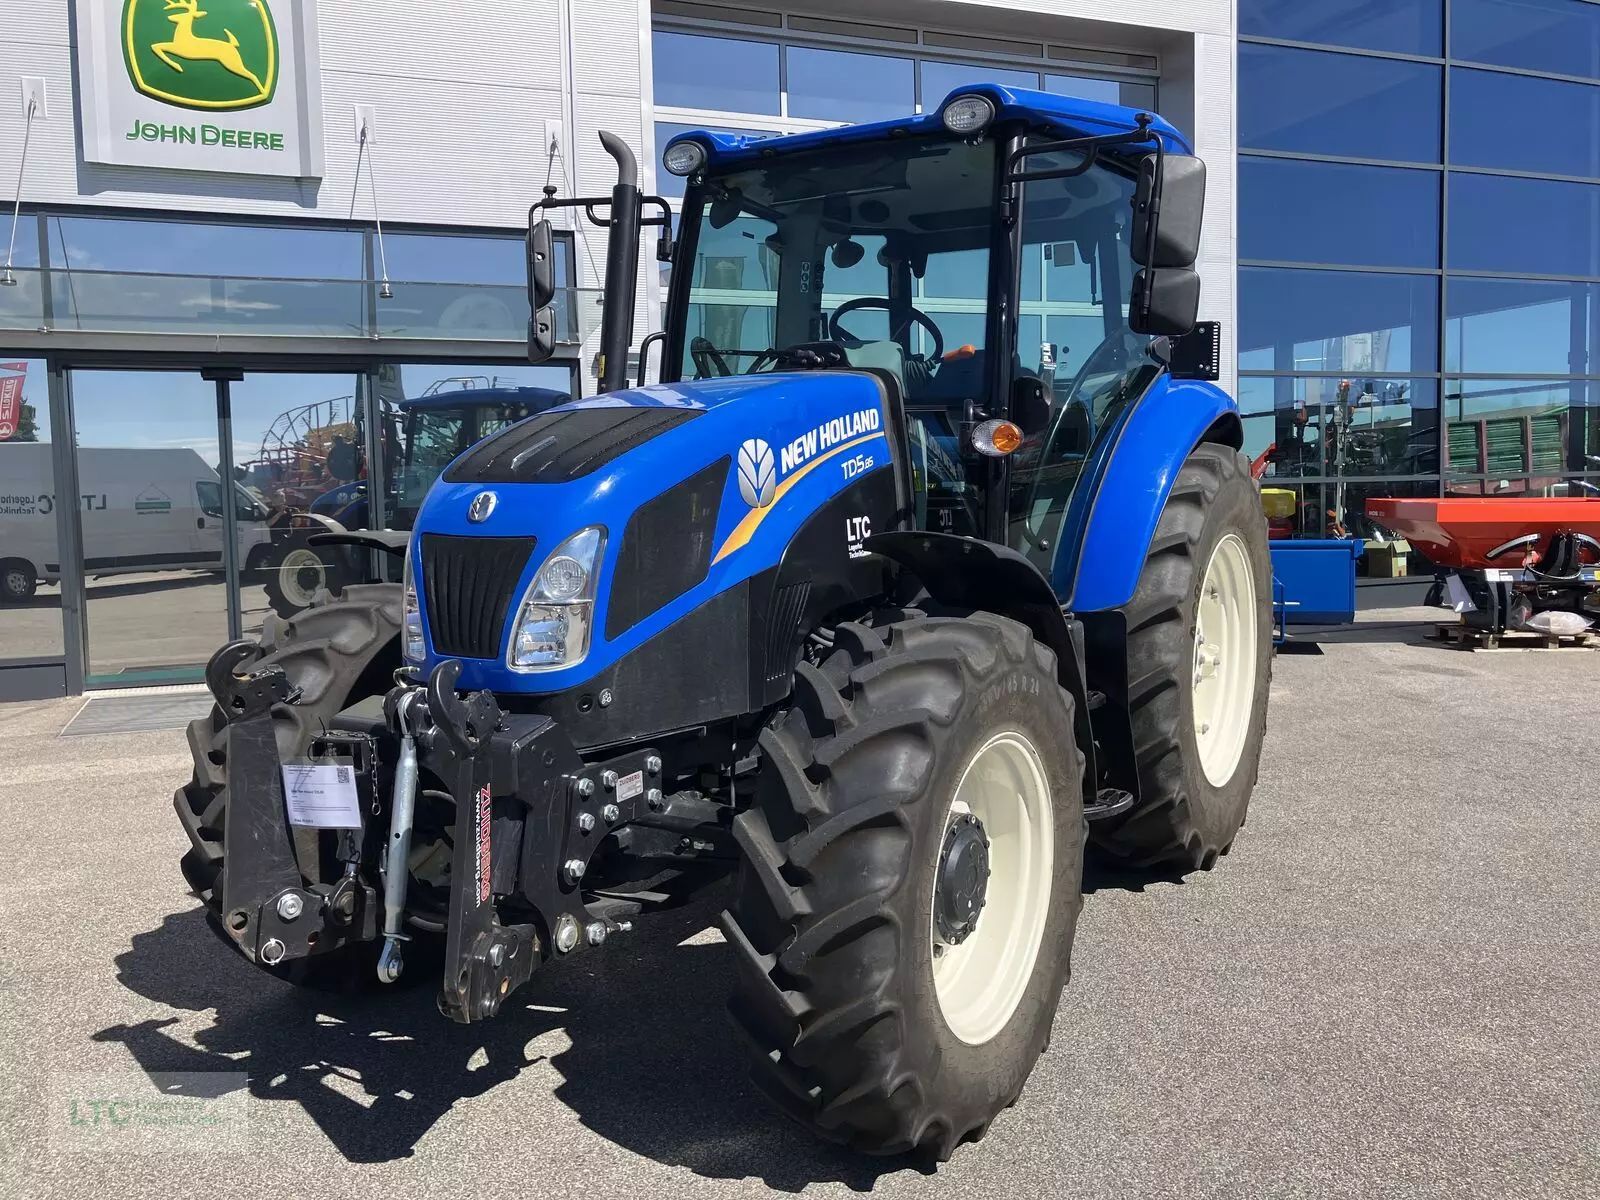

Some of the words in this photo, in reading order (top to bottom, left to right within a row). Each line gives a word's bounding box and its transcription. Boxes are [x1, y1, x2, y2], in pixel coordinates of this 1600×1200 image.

[126, 119, 196, 144] JOHN
[201, 124, 284, 151] DEERE
[780, 429, 817, 475] NEW
[819, 408, 879, 450] HOLLAND
[846, 515, 871, 541] LTC
[481, 783, 491, 901] ZUIDBERG
